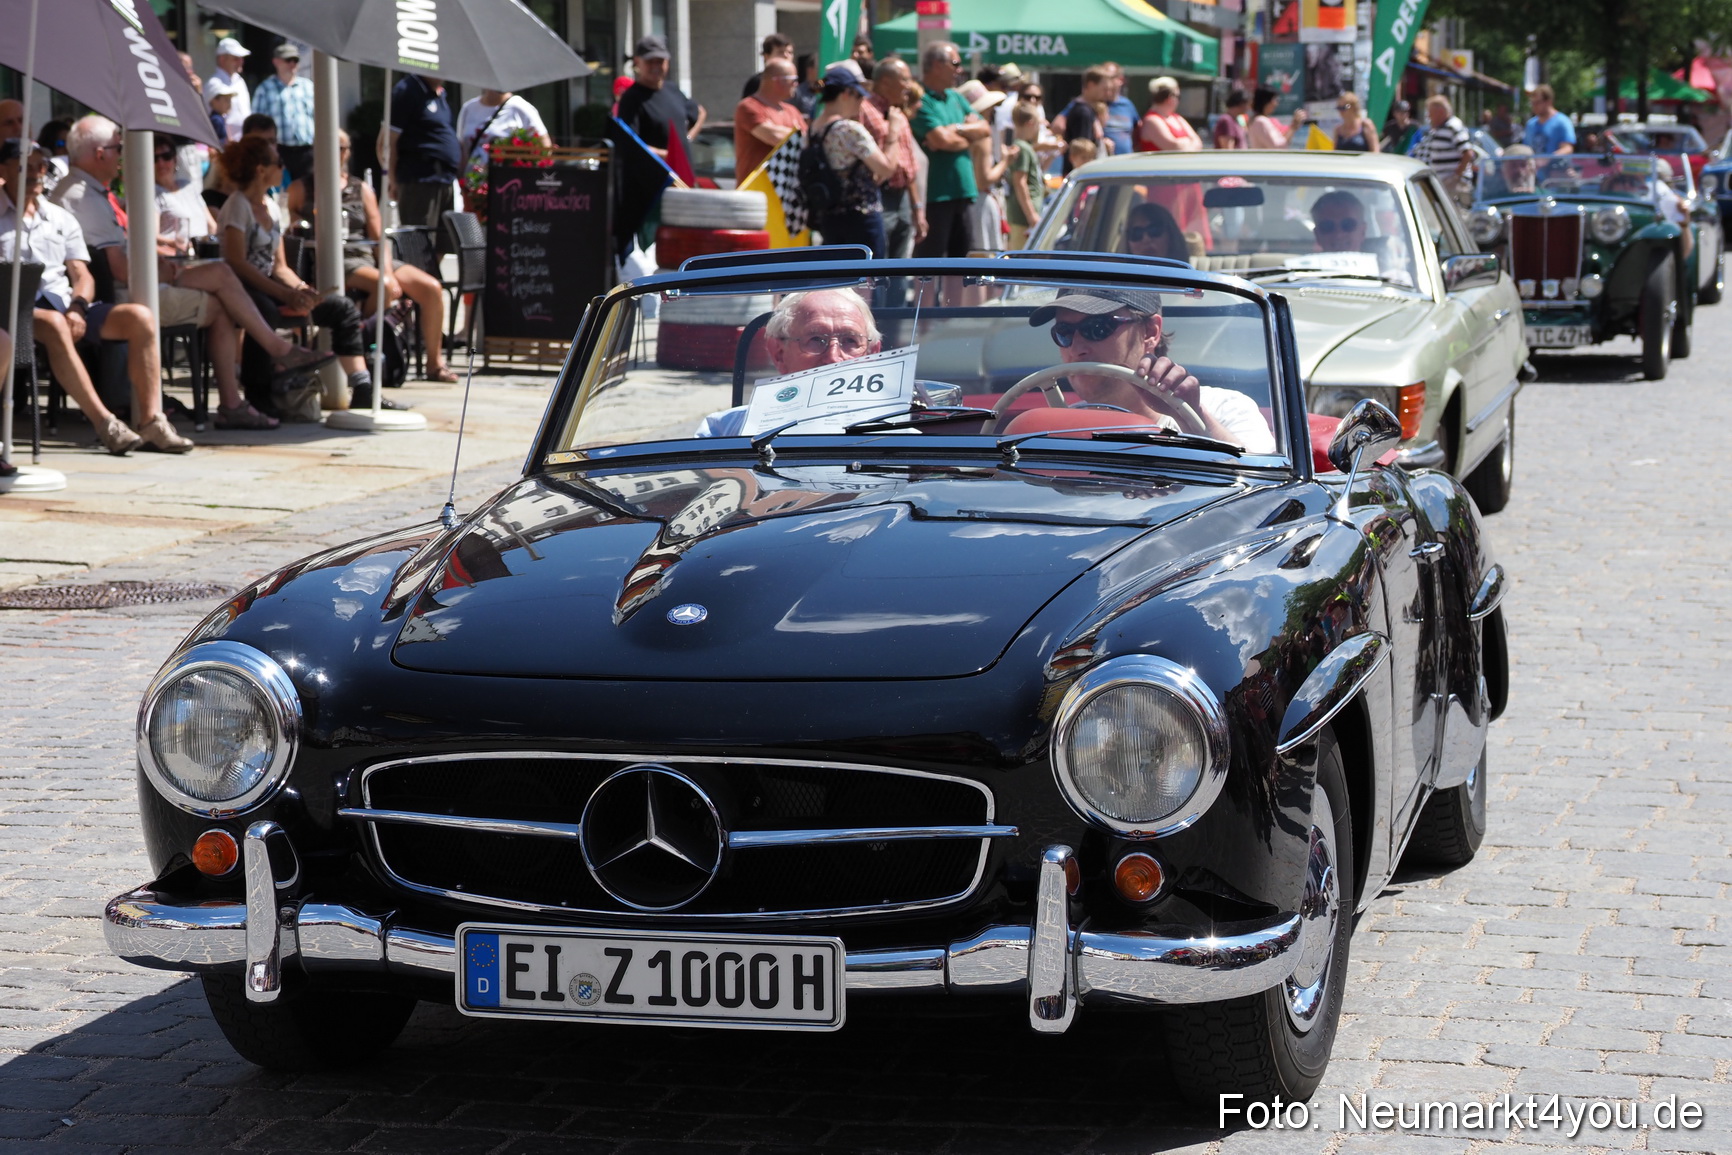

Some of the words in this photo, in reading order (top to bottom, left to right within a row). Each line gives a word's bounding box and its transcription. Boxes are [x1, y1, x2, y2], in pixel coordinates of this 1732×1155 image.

[996, 34, 1069, 56] DEKRA
[122, 26, 177, 117] now
[1535, 328, 1554, 344] TC
[827, 373, 885, 397] 246
[506, 943, 566, 1002] EI
[477, 977, 490, 994] D
